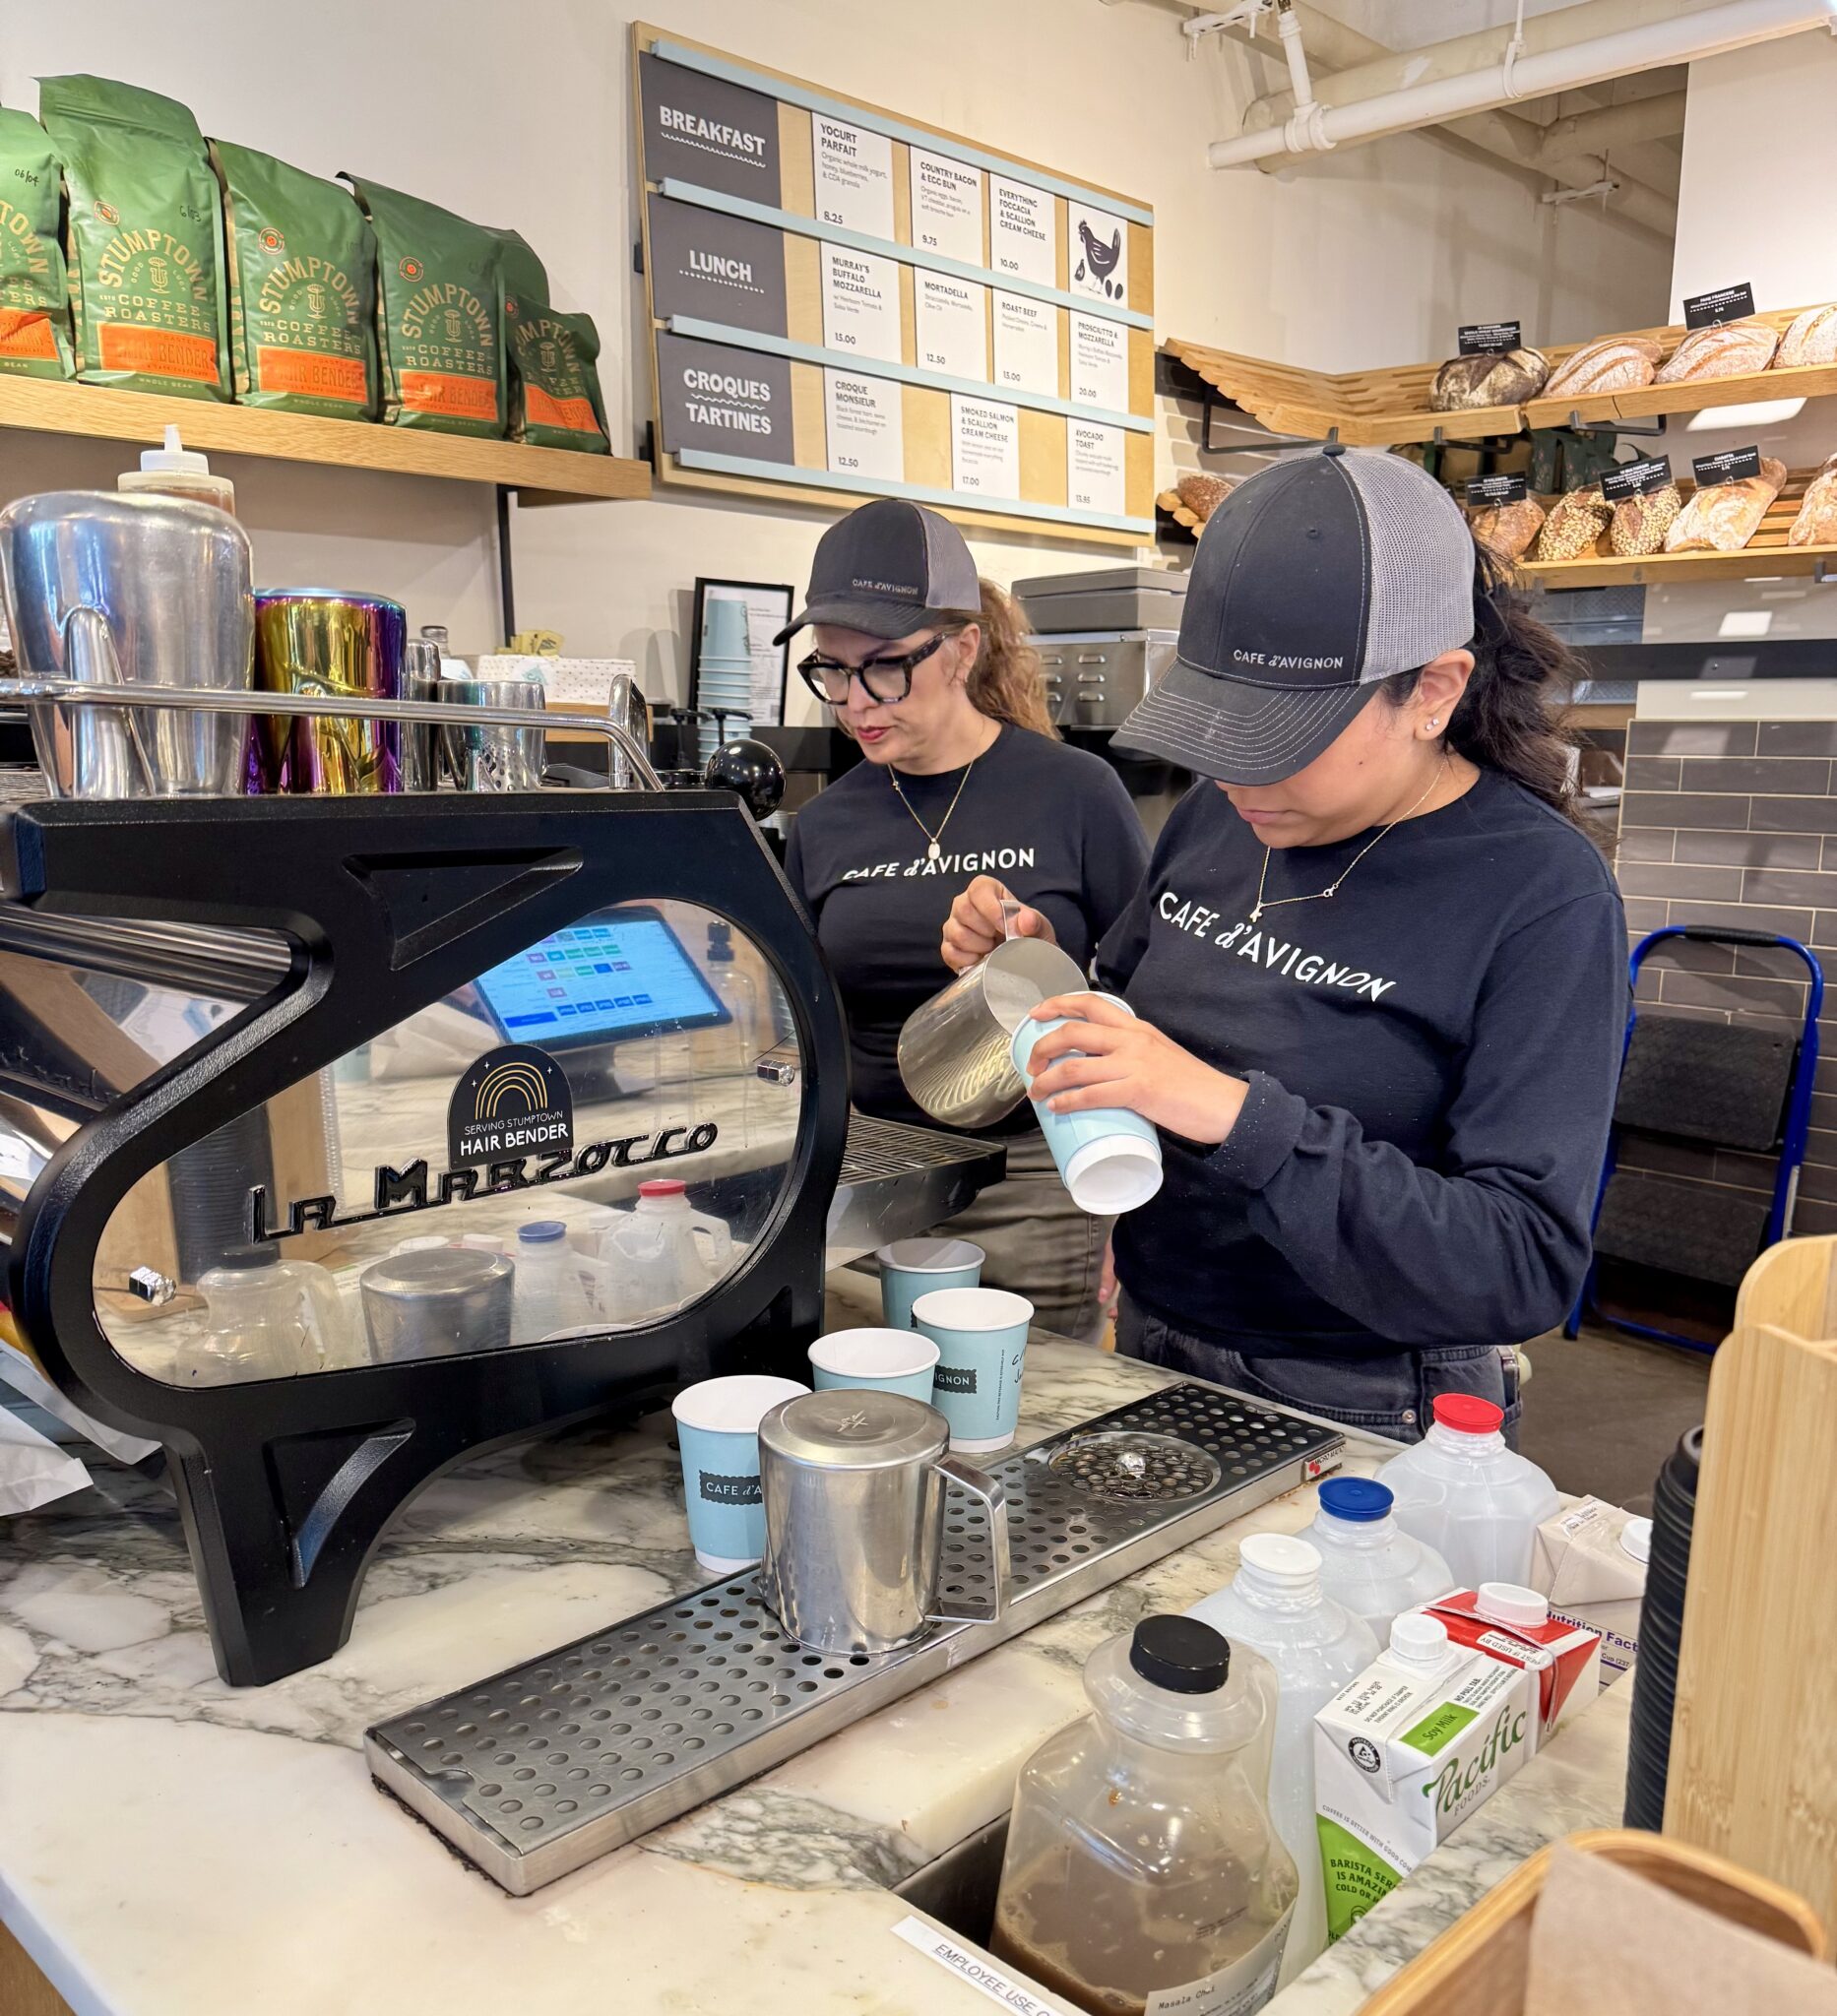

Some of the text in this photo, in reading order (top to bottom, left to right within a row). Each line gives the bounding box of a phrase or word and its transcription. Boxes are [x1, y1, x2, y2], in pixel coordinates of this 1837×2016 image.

[660, 104, 766, 157] BREAKFAST
[820, 123, 857, 144] YOGURT
[821, 138, 857, 157] PARFAIT
[920, 161, 978, 188] COUNTRY BACON
[927, 175, 942, 186] EGG
[942, 179, 957, 191] BUN
[999, 188, 1038, 208] EVERYTHING
[824, 211, 844, 224] 8.25
[1006, 212, 1036, 227] SCALLION
[999, 220, 1046, 241] CREAM CHEESE
[922, 234, 937, 247] 9.75
[98, 228, 208, 302] STUMPTOWN
[689, 249, 753, 283] LUNCH
[832, 256, 870, 274] MURRAY'S
[1000, 258, 1019, 271] 10.00
[833, 269, 865, 284] BUFFALO
[259, 256, 361, 325] STUMPTOWN
[833, 280, 882, 299] MOZZARELLA
[924, 282, 969, 299] MORTADELLA
[118, 294, 201, 316] COFFEE
[1002, 301, 1038, 318] ROAST BEEF
[104, 306, 212, 333] ROASTERS
[402, 284, 493, 346] STUMPTOWN
[277, 319, 351, 340] COFFEE
[1078, 322, 1113, 339] PROSCIUTTO
[263, 331, 361, 354] ROASTERS
[835, 333, 856, 346] 15.00
[1078, 332, 1114, 347] MOZZARELLA
[158, 344, 210, 369] BENDER
[417, 345, 486, 362] COFFEE
[406, 355, 492, 375] ROASTERS
[683, 368, 772, 402] CROQUES
[835, 380, 868, 395] CROQUE
[836, 393, 876, 409] MONSIEUR
[685, 403, 773, 435] TARTINES
[961, 406, 1015, 423] SMOKED SALMON
[967, 417, 998, 431] SCALLION
[961, 426, 1009, 443] CREAM CHEESE
[1076, 429, 1104, 442] AVOCADO
[1076, 439, 1095, 450] TOAST
[838, 456, 858, 468] 12.50
[962, 475, 980, 486] 17.00
[853, 578, 918, 595] CAFE d'AVIGNON
[1234, 649, 1344, 669] CAFE d'AVIGNON
[842, 848, 1035, 880] CAFE d'AVIGNON
[1159, 891, 1397, 1002] CAFE d'AVIGNON
[464, 1110, 564, 1136] SERVING STUMPTOWN
[460, 1122, 569, 1157] HAIR BENDER
[934, 1372, 970, 1386] IGNON
[706, 1481, 738, 1495] CAFE
[1481, 1637, 1491, 1646] BY
[1491, 1642, 1513, 1654] USED
[1607, 1631, 1638, 1653] Fact
[1422, 1714, 1458, 1740] Soy Milk
[1422, 1705, 1526, 1813] Pacific
[1330, 1858, 1371, 1876] BARISTA
[1336, 1883, 1371, 1899] COLD OR
[1337, 1871, 1387, 1897] IS AMAZIN
[934, 1943, 1038, 2013] EMPLOYEE USE
[1158, 1996, 1192, 2010] Masala
